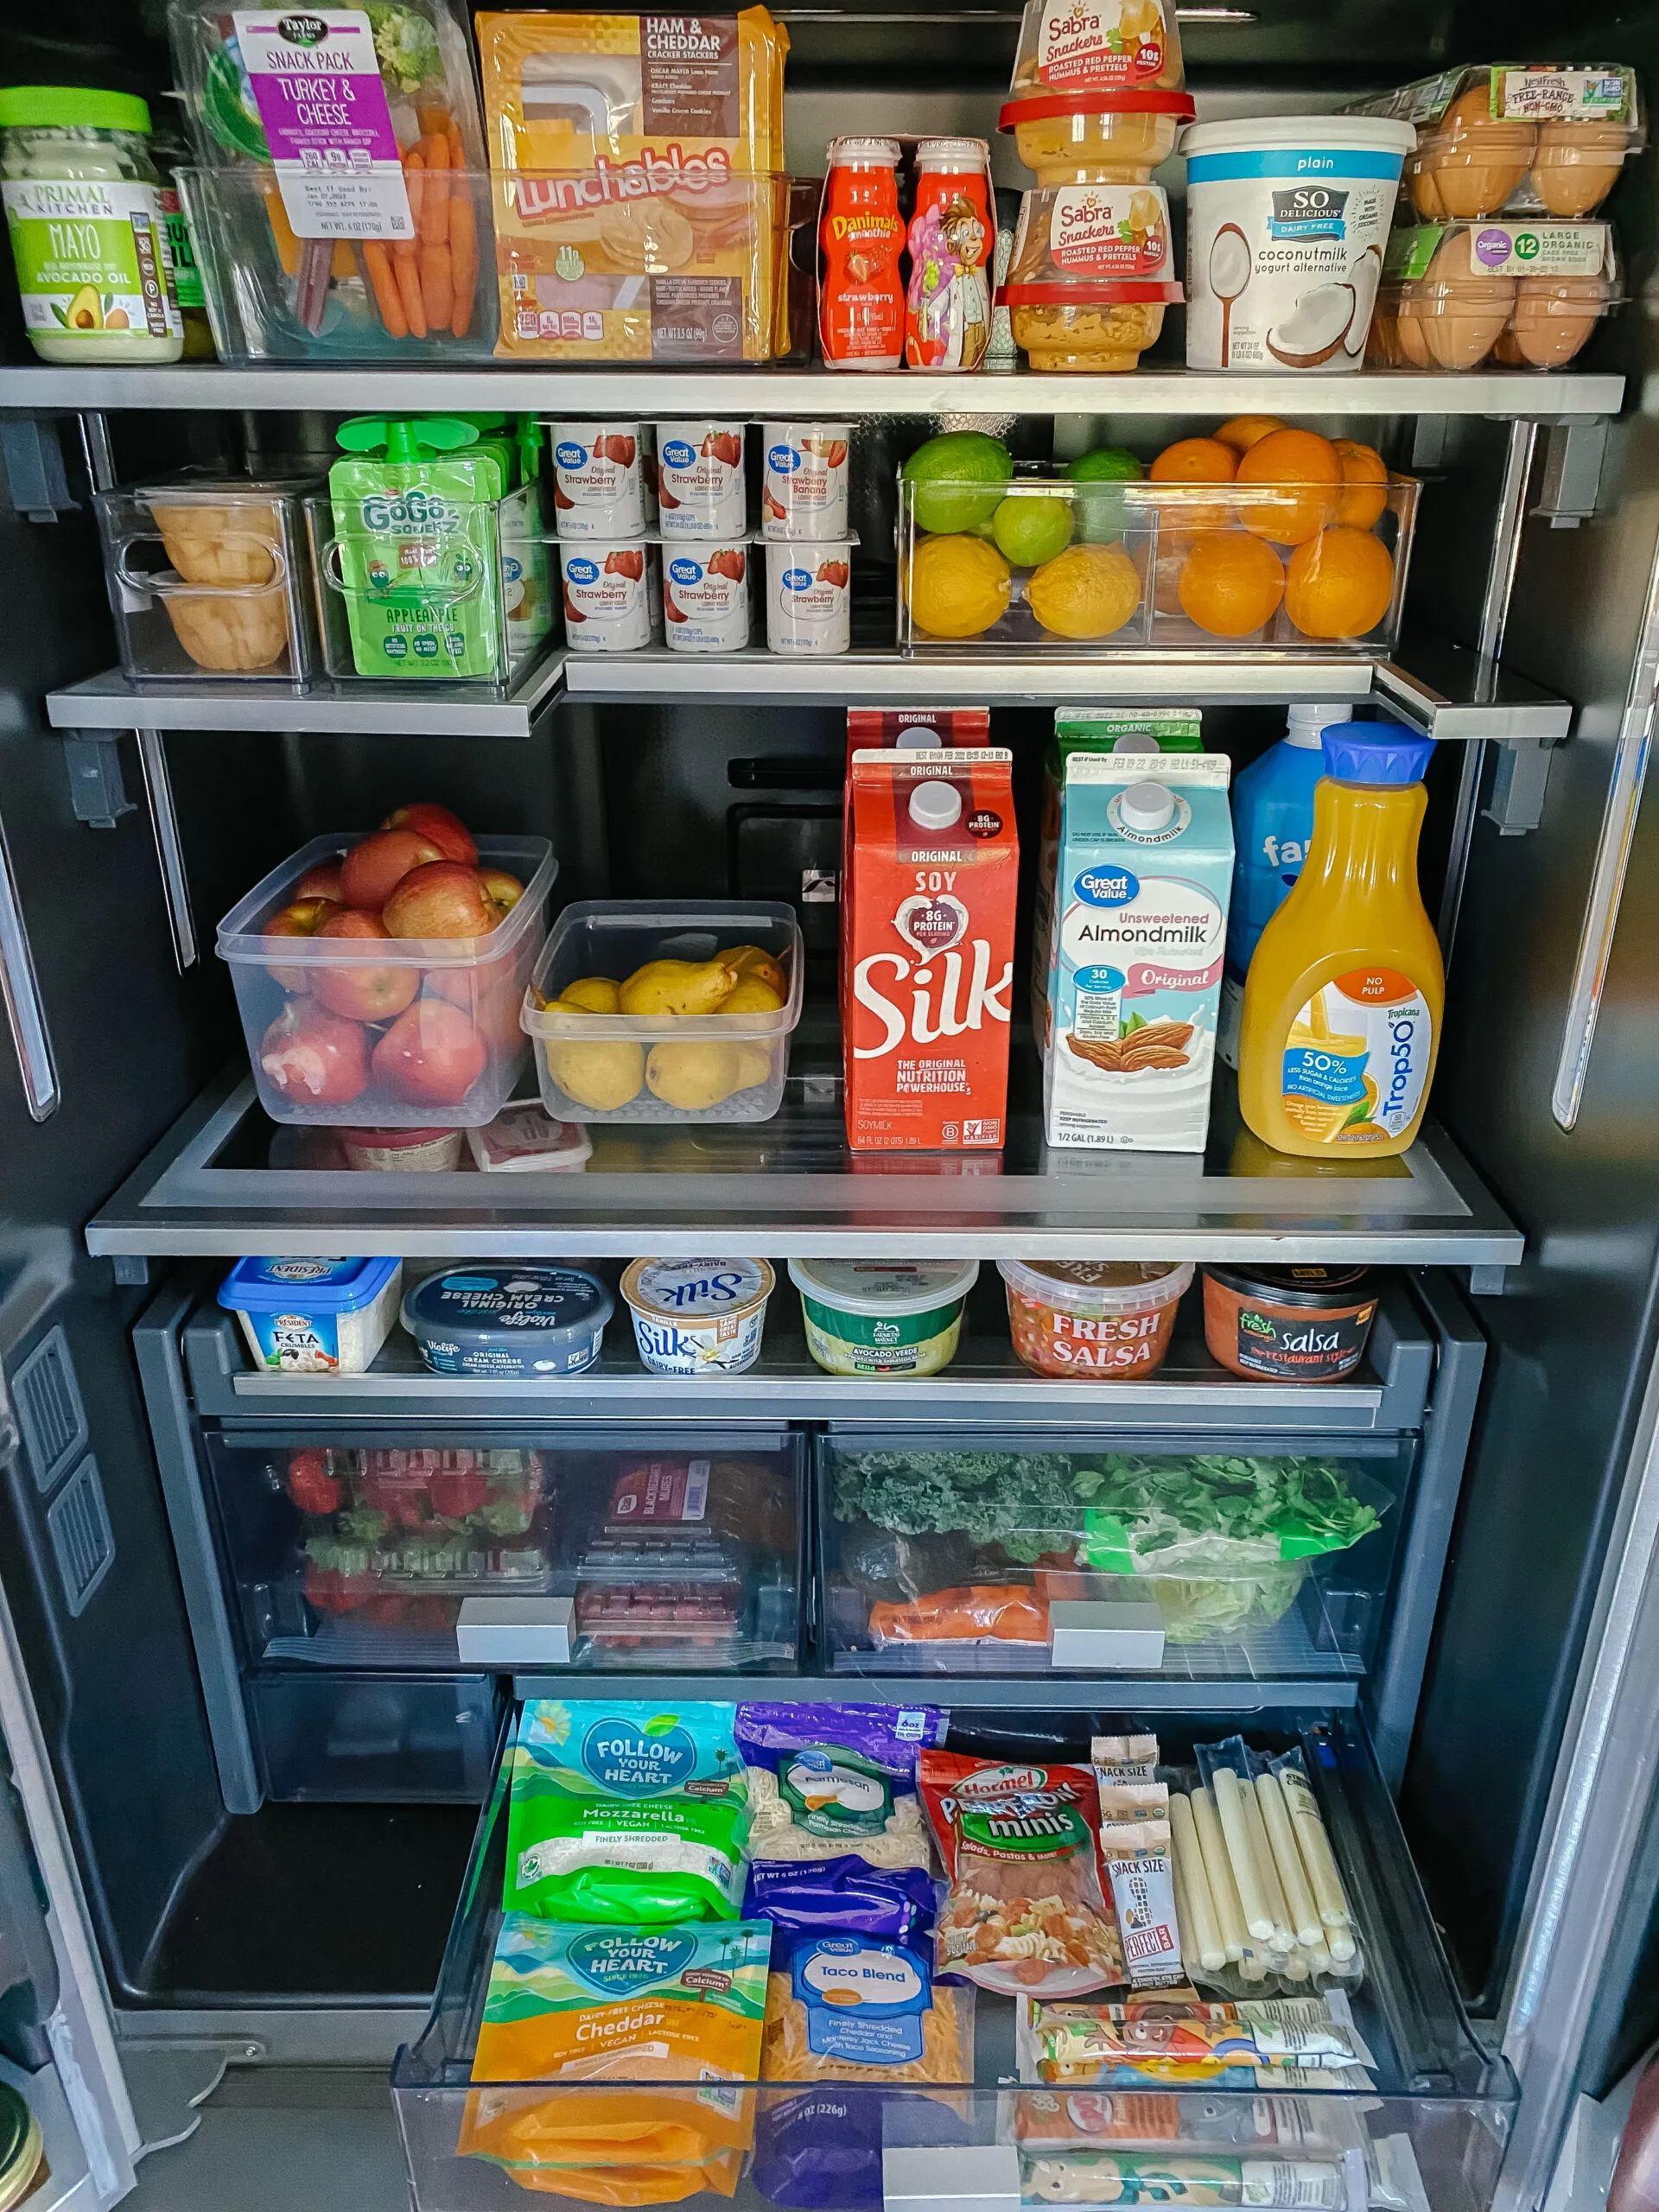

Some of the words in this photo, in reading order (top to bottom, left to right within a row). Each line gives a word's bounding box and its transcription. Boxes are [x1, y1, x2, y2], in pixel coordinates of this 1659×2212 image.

[282, 18, 322, 32] Taylor
[647, 18, 684, 34] HAM
[690, 18, 702, 34] &
[1050, 15, 1101, 41] Sabra
[647, 35, 721, 50] CHEDDAR
[1046, 36, 1103, 62] Snackers
[266, 52, 313, 70] SNACK
[317, 52, 354, 70] PACK
[1049, 57, 1083, 73] ROASTED
[1084, 56, 1101, 66] RED
[1103, 54, 1132, 64] PEPPER
[1049, 67, 1081, 81] HUMMUS
[1083, 66, 1089, 74] &
[1090, 61, 1128, 73] PRETZELS
[277, 78, 336, 102] TURKEY
[342, 78, 356, 101] &
[1513, 89, 1575, 105] FREE-RANGE
[1523, 101, 1563, 113] NON-GMO
[296, 104, 352, 125] CHEESE
[1298, 156, 1333, 172] plain
[518, 148, 727, 214] Lunchables
[35, 185, 110, 203] PRIMAL
[1294, 191, 1329, 208] SO
[1061, 205, 1112, 227] Sabra
[1280, 209, 1338, 218] DELICIOUS
[832, 211, 899, 241] Danimals
[1281, 225, 1309, 233] DAIRY
[48, 224, 100, 259] MAYO
[1058, 225, 1114, 246] Snackers
[1061, 248, 1096, 258] ROASTED
[1115, 245, 1141, 254] PEPPER
[1478, 240, 1507, 251] Organic
[1517, 238, 1536, 254] 12
[1061, 255, 1094, 265] HUMMUS
[1103, 252, 1136, 262] PRETZELS
[1259, 247, 1348, 261] coconutmilk
[1255, 263, 1289, 274] yogurt
[1294, 262, 1347, 273] alternative
[37, 271, 102, 283] AVOCADO
[108, 271, 131, 284] OIL
[837, 293, 893, 303] strawberry
[557, 448, 581, 458] Great
[665, 447, 689, 456] Great
[771, 451, 794, 461] Great
[565, 474, 616, 486] Strawberry
[671, 474, 723, 486] Strawberry
[363, 492, 445, 531] GoGo
[569, 564, 593, 574] Great
[672, 564, 696, 574] Great
[576, 589, 627, 600] Strawberry
[679, 590, 729, 601] Strawberry
[899, 715, 937, 723] ORIGINAL
[1107, 723, 1151, 733] ORGANIC
[911, 766, 953, 776] ORIGINAL
[1117, 826, 1184, 843] Almondmilk
[912, 851, 963, 862] ORIGINAL
[915, 871, 957, 892] SOY
[1081, 874, 1128, 890] Great
[1092, 887, 1127, 899] Value
[925, 910, 942, 921] 8G
[1120, 912, 1209, 925] Unsweetened
[913, 921, 953, 931] PROTEIN
[1077, 925, 1207, 943] Almondmilk
[1091, 969, 1107, 979] 30
[1141, 969, 1209, 989] Original
[854, 938, 1014, 1058] Silk
[1362, 987, 1385, 995] PULP
[1388, 1007, 1420, 1019] Tropicana
[897, 1060, 915, 1070] THE
[918, 1059, 966, 1069] ORIGINAL
[1302, 1052, 1346, 1074] 50%
[897, 1070, 966, 1083] NUTRITION
[1302, 1069, 1322, 1078] SUGAR
[896, 1083, 965, 1093] POWERHOUSE
[857, 1120, 892, 1130] SOYMILK
[442, 1292, 504, 1300] CHEESE
[657, 1273, 742, 1306] Silk
[462, 1300, 537, 1309] ORIGINAL
[499, 1311, 556, 1326] Violife
[1052, 1313, 1161, 1342] FRESH
[1240, 1313, 1277, 1339] fresh
[272, 1332, 320, 1344] FETA
[639, 1320, 696, 1356] Silk
[1280, 1328, 1339, 1352] salsa
[427, 1340, 461, 1357] Violife
[854, 1348, 892, 1357] AVOCADO
[895, 1348, 918, 1357] VERDE
[1052, 1340, 1151, 1368] SALSA
[647, 1356, 696, 1375] DAIRY-FREE
[643, 1464, 662, 1515] BLACKBERRIES
[597, 1738, 683, 1764] FOLLOW
[619, 1758, 661, 1771] YOUR
[1128, 1766, 1147, 1777] SIZE
[605, 1770, 672, 1784] HEART
[964, 1770, 1034, 1795] Hormel
[687, 1784, 724, 1794] Calcium
[583, 1808, 684, 1822] Mozzarella
[988, 1812, 1075, 1837] minis
[994, 1850, 1027, 1860] Pastas
[1111, 1861, 1141, 1878] SNACK
[1144, 1859, 1165, 1873] SIZE
[583, 1936, 683, 1953] FOLLOW
[1158, 1928, 1171, 1948] BAR
[1124, 1930, 1160, 1961] PERFECT
[607, 1948, 656, 1959] YOUR
[591, 1959, 666, 1974] HEART
[822, 1966, 858, 1978] Taco
[862, 1968, 906, 1983] Blend
[685, 1976, 724, 1988] Calcium
[579, 2006, 629, 2022] DAIRY-FREE
[632, 2002, 665, 2012] CHEESE
[576, 2013, 665, 2041] Cheddar
[840, 2028, 875, 2037] Cheddar
[857, 2022, 903, 2035] Shredded
[600, 2034, 637, 2048] VEGAN
[817, 2104, 847, 2116] (226g)
